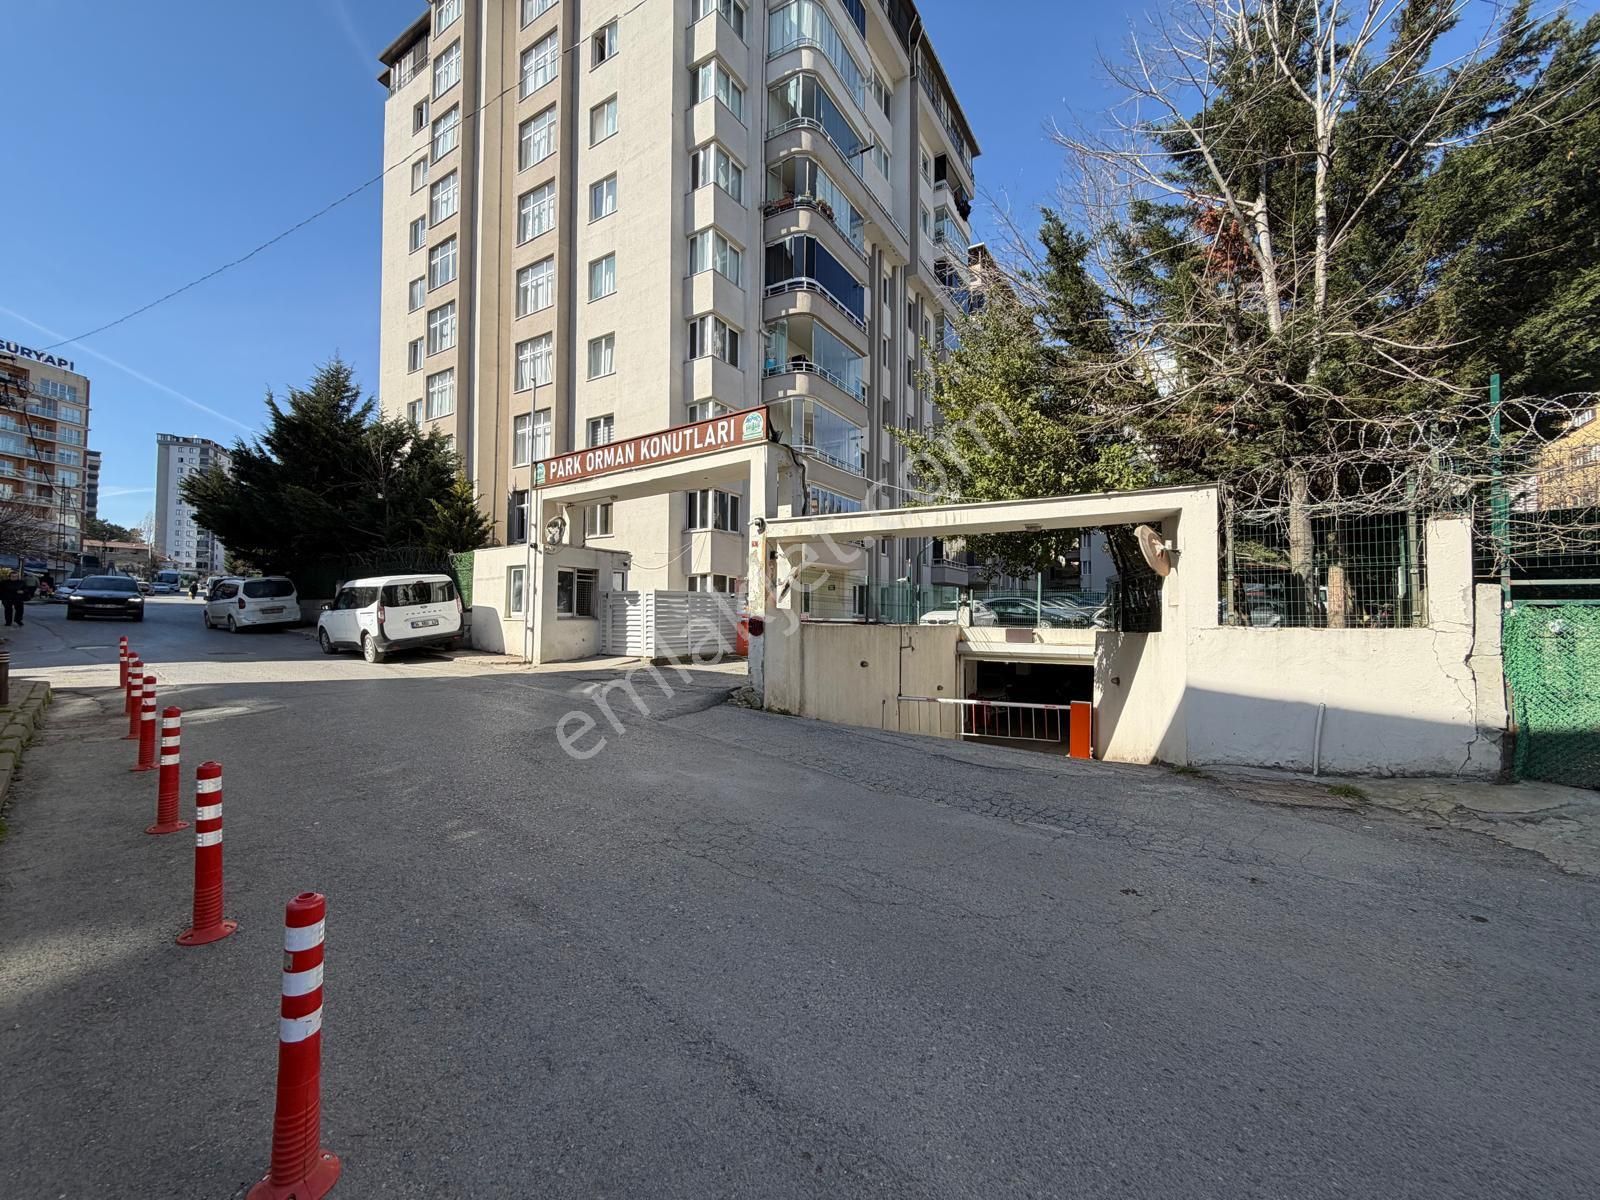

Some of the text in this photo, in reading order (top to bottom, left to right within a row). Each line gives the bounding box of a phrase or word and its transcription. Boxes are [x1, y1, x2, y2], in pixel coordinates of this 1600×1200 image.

[550, 418, 735, 480] PARK ORMAN KONUTLARI
